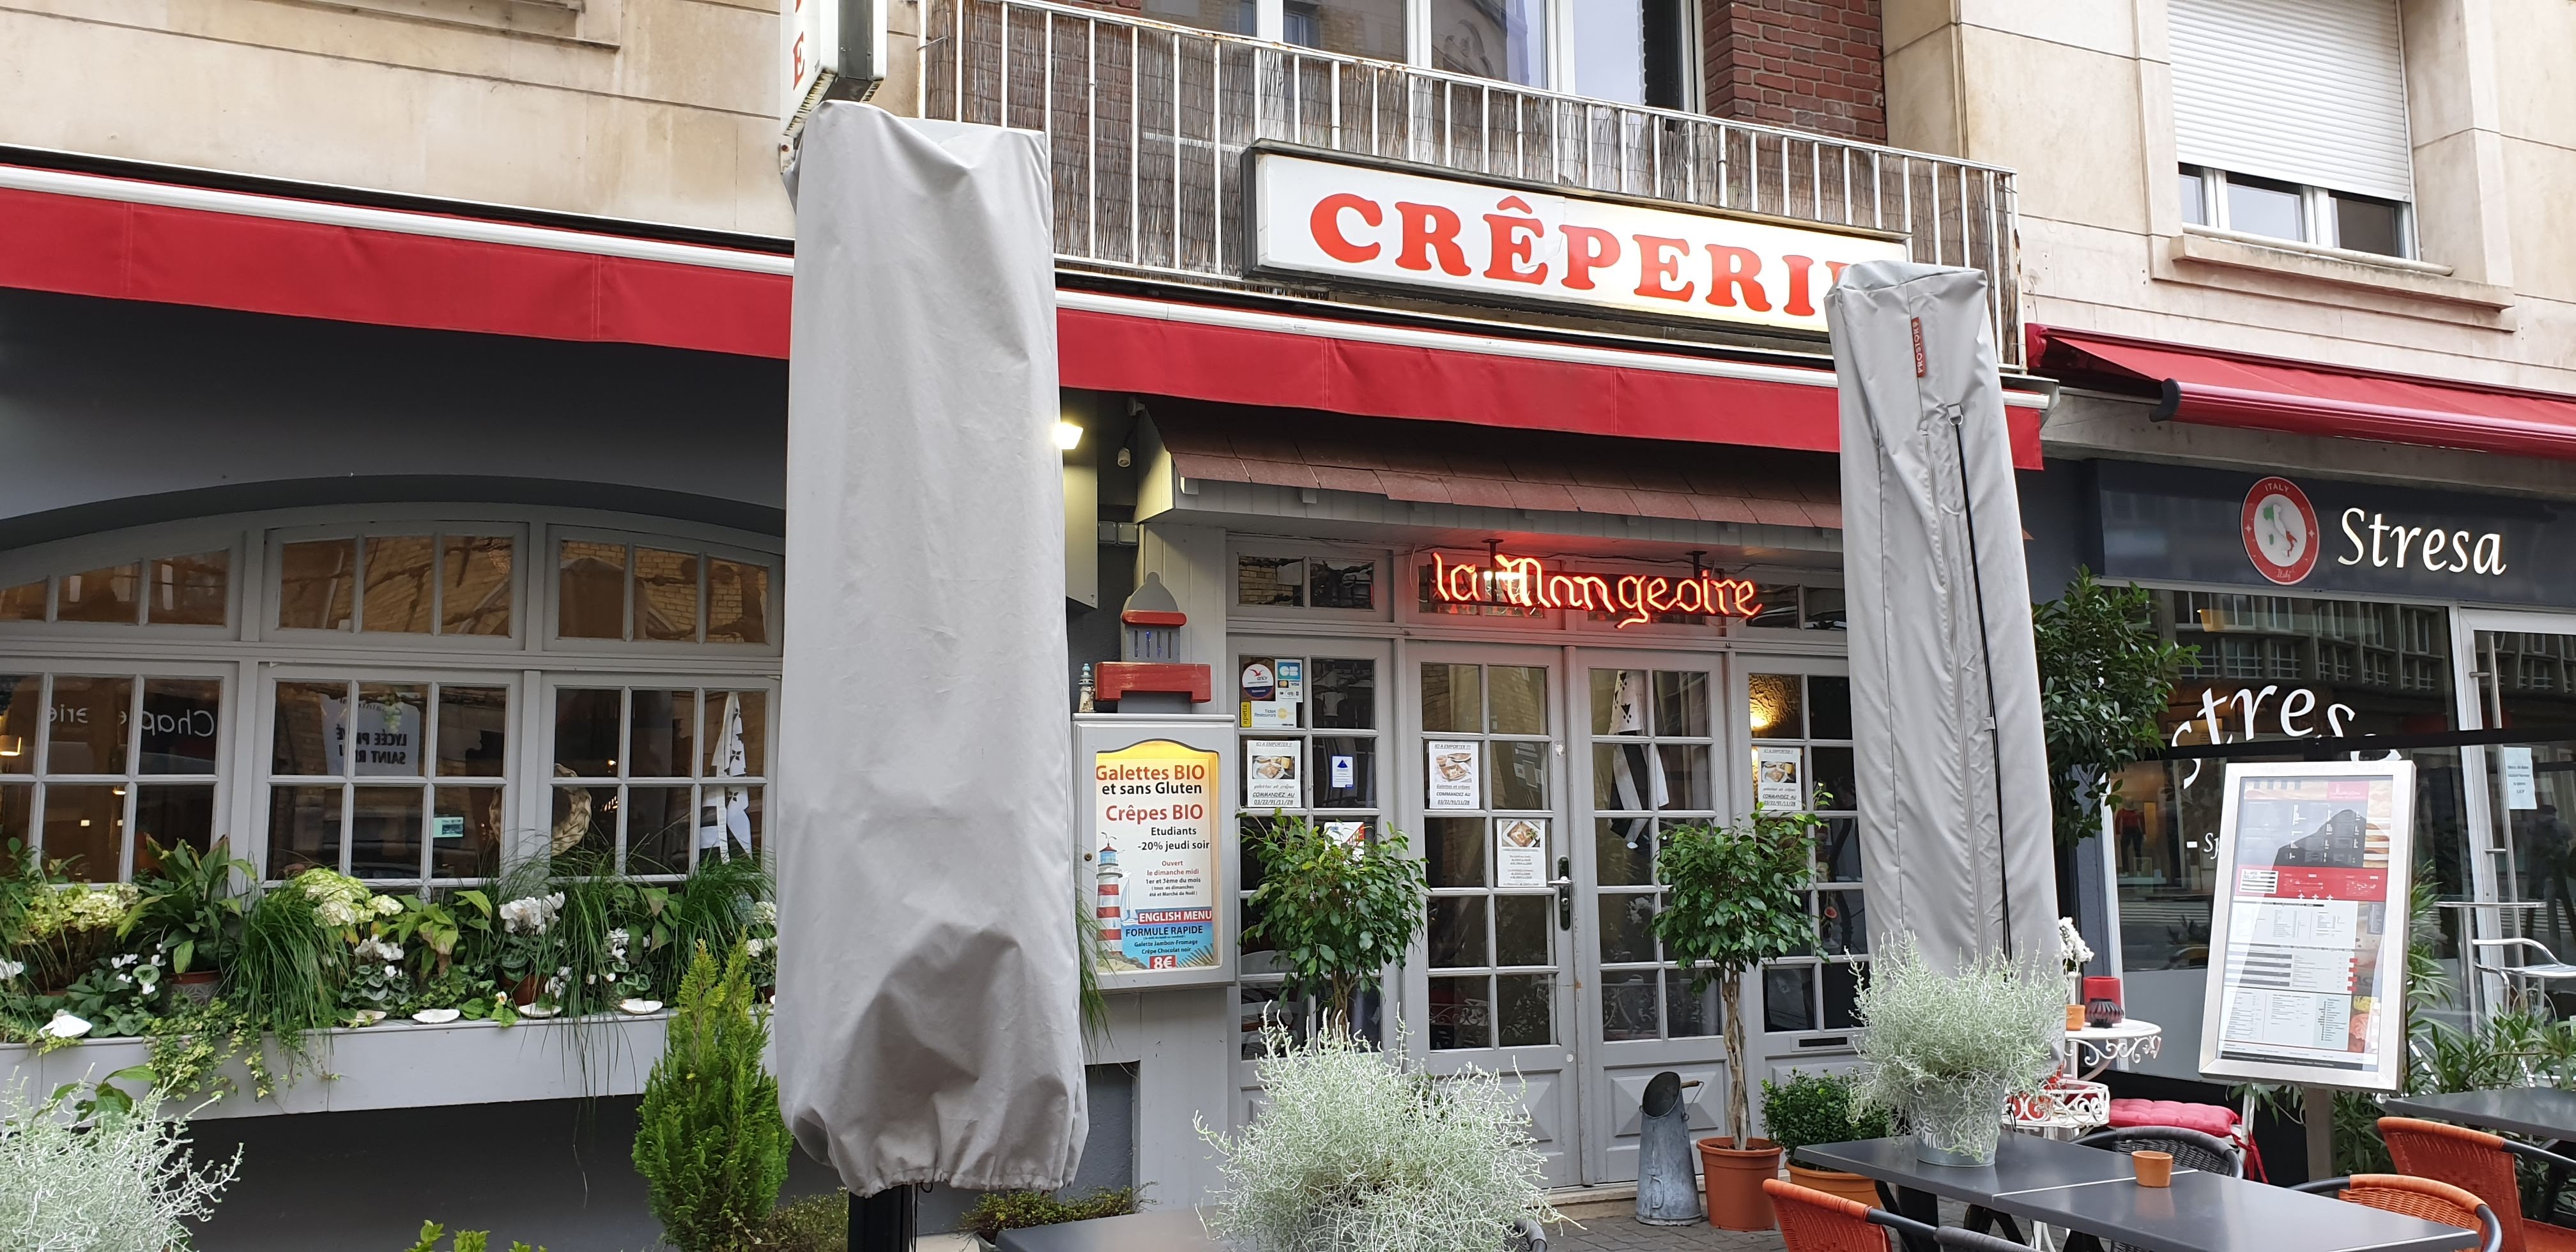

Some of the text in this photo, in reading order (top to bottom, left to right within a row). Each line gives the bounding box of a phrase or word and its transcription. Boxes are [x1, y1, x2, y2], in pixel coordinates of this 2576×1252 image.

[1310, 192, 1845, 317] CRÊPERI
[2265, 483, 2289, 492] ITALY
[2337, 507, 2507, 576] Stresa
[1432, 552, 1763, 629] la Mangeoire
[1096, 765, 1205, 781] Galettes BIO
[1102, 781, 1202, 795] et sans Gluten
[1106, 804, 1203, 825] Crêpes BIO
[1151, 827, 1197, 836] Etudiants
[1137, 840, 1210, 852] -20% jeudi soir
[1139, 910, 1212, 922] ENGLISH MENU
[1126, 927, 1169, 937] FORMULE
[1170, 926, 1203, 935] RAPIDE
[1154, 956, 1174, 970] 8€
